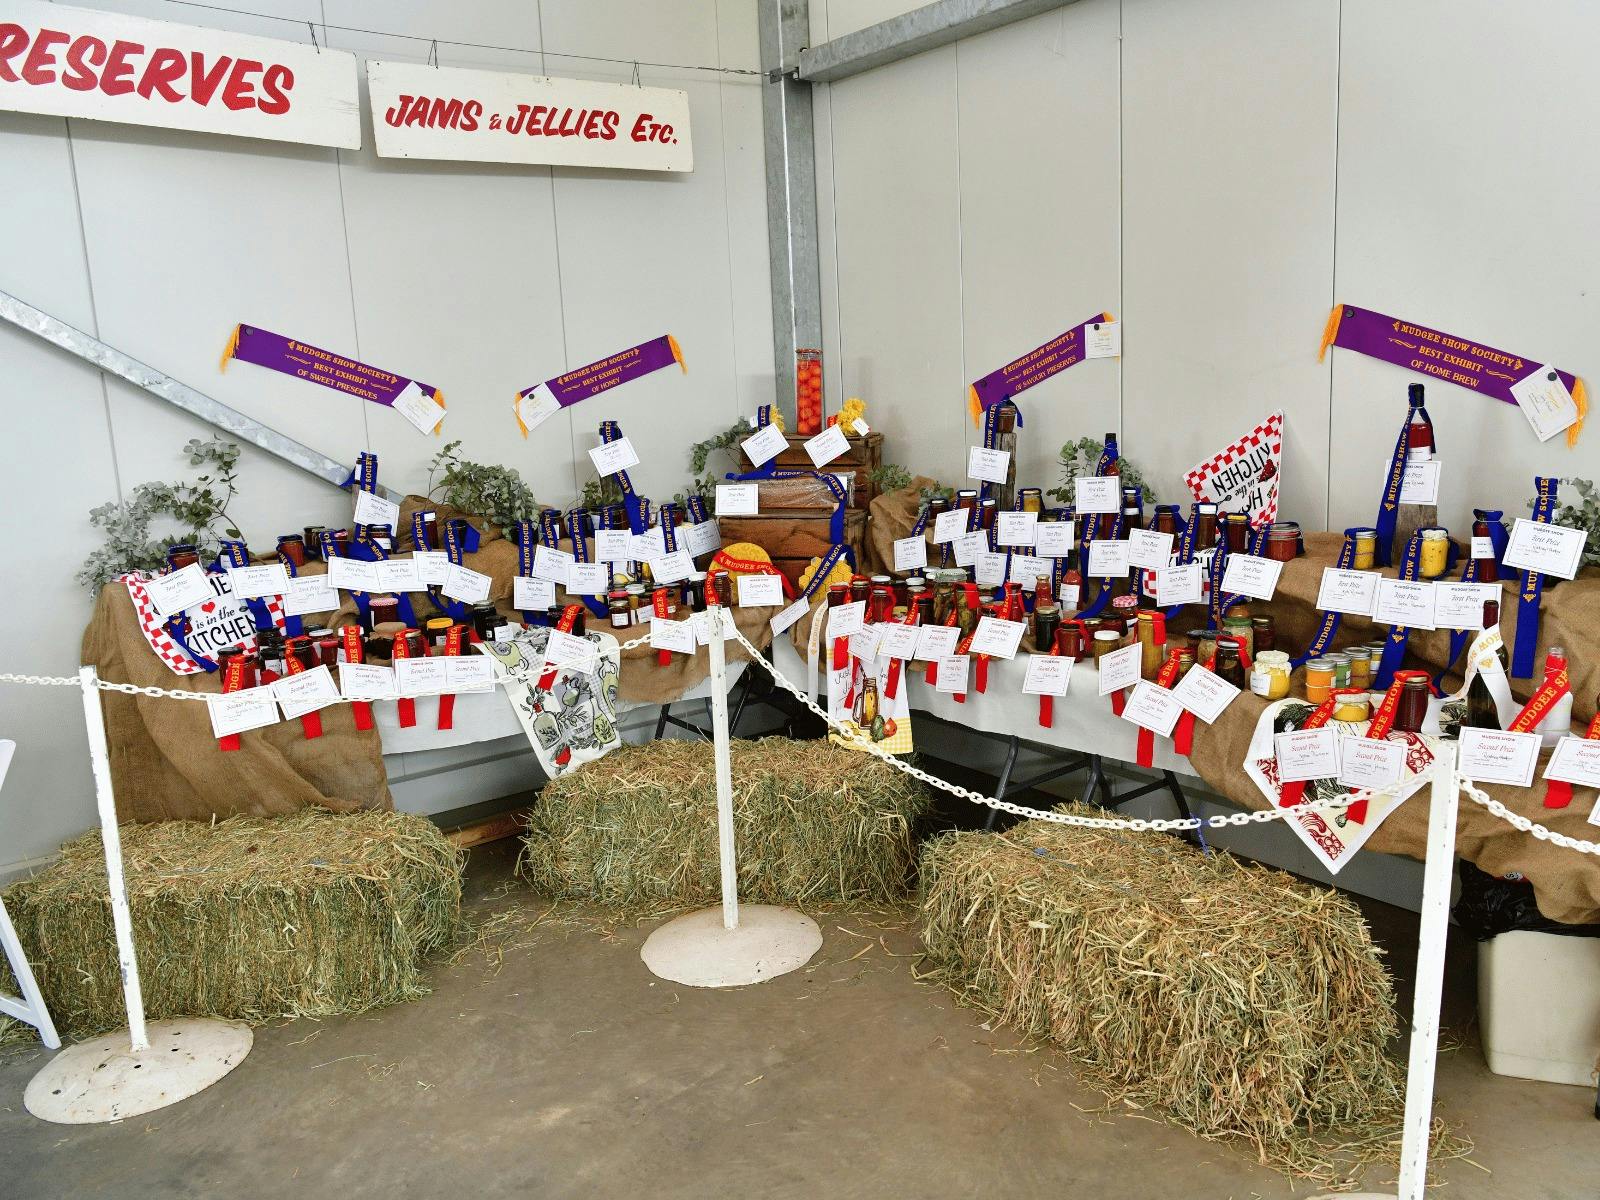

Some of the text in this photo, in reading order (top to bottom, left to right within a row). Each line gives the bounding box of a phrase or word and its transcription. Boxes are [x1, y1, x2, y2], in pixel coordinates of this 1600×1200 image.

[386, 94, 482, 132] JAMS
[488, 114, 502, 131] &
[507, 104, 620, 140] JELLIES
[1046, 336, 1070, 351] SOCIETY
[1401, 325, 1514, 367] MUDGEE SHOW SOCIETY
[296, 344, 391, 382] MUDGEE SHOW SOCIETY
[564, 350, 635, 382] MUDGEE SHOW SOCIETY
[1023, 353, 1058, 375] BEST EXHIBIT
[1419, 346, 1483, 372] BEST EXHIBIT
[297, 369, 378, 399] OF SWEET PRESERVES
[314, 363, 368, 385] BEST EXHIBIT
[582, 366, 623, 386] BEST EXHIBIT
[600, 377, 620, 390] HONEY
[1016, 356, 1077, 391] OF SAVOURY PRESERVES
[1411, 360, 1479, 387] OF HOME BREW
[1388, 432, 1406, 500] MUDGEE SHOW
[1540, 479, 1548, 511] SOCIE
[1086, 513, 1096, 540] MUDGE
[232, 544, 243, 566] SHOW
[576, 535, 584, 552] SHOW
[1183, 536, 1191, 560] SHOW
[818, 560, 832, 580] SHOW
[1214, 549, 1223, 572] SHOW
[1405, 560, 1414, 581] HOW
[196, 605, 235, 629] is in the
[1315, 614, 1335, 650] MUDGEE
[1512, 687, 1558, 734] MUDGEE
[1371, 716, 1388, 739] GEE
